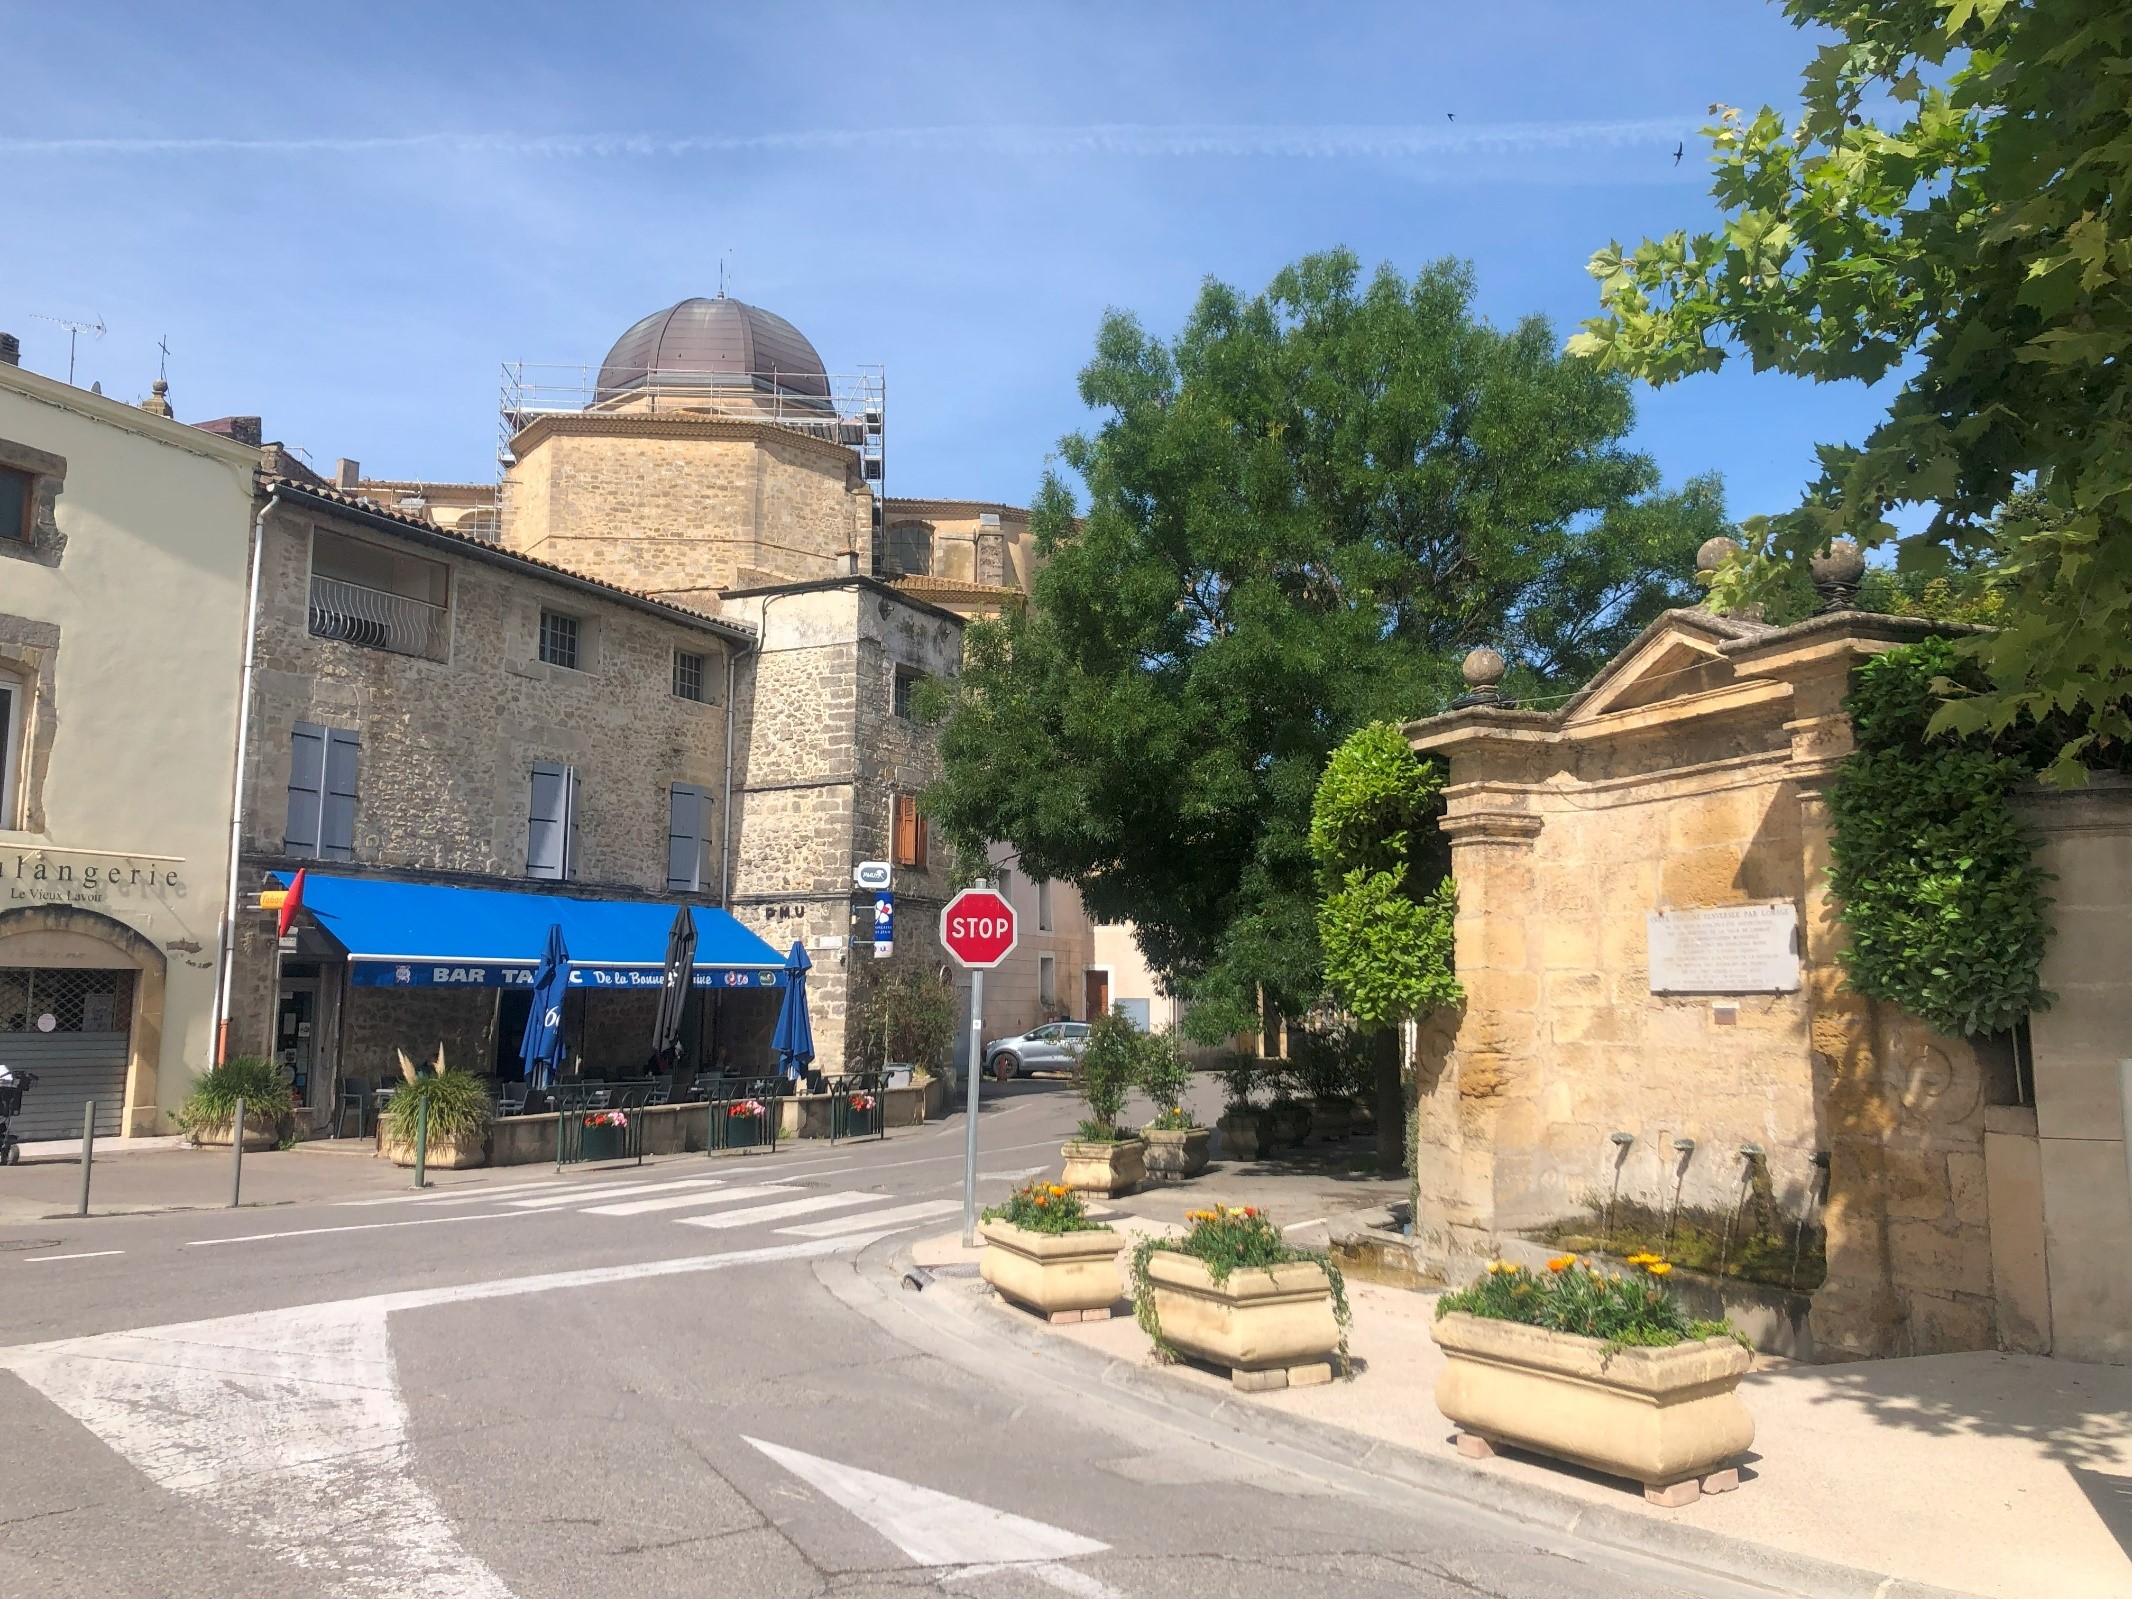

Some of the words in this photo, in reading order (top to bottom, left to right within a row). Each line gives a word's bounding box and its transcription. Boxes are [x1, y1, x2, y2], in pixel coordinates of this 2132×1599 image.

[0, 855, 178, 889] langerie
[11, 888, 26, 899] Le
[29, 888, 63, 901] Vieux
[67, 889, 103, 902] Lavoir
[262, 895, 283, 905] Tabac
[765, 905, 805, 921] PMU
[1743, 910, 1758, 918] PAR
[951, 917, 1009, 939] STOP
[433, 967, 486, 983] BAR
[501, 969, 583, 984] TAC
[593, 970, 613, 984] De
[614, 971, 629, 984] la
[629, 971, 665, 985] Bonne
